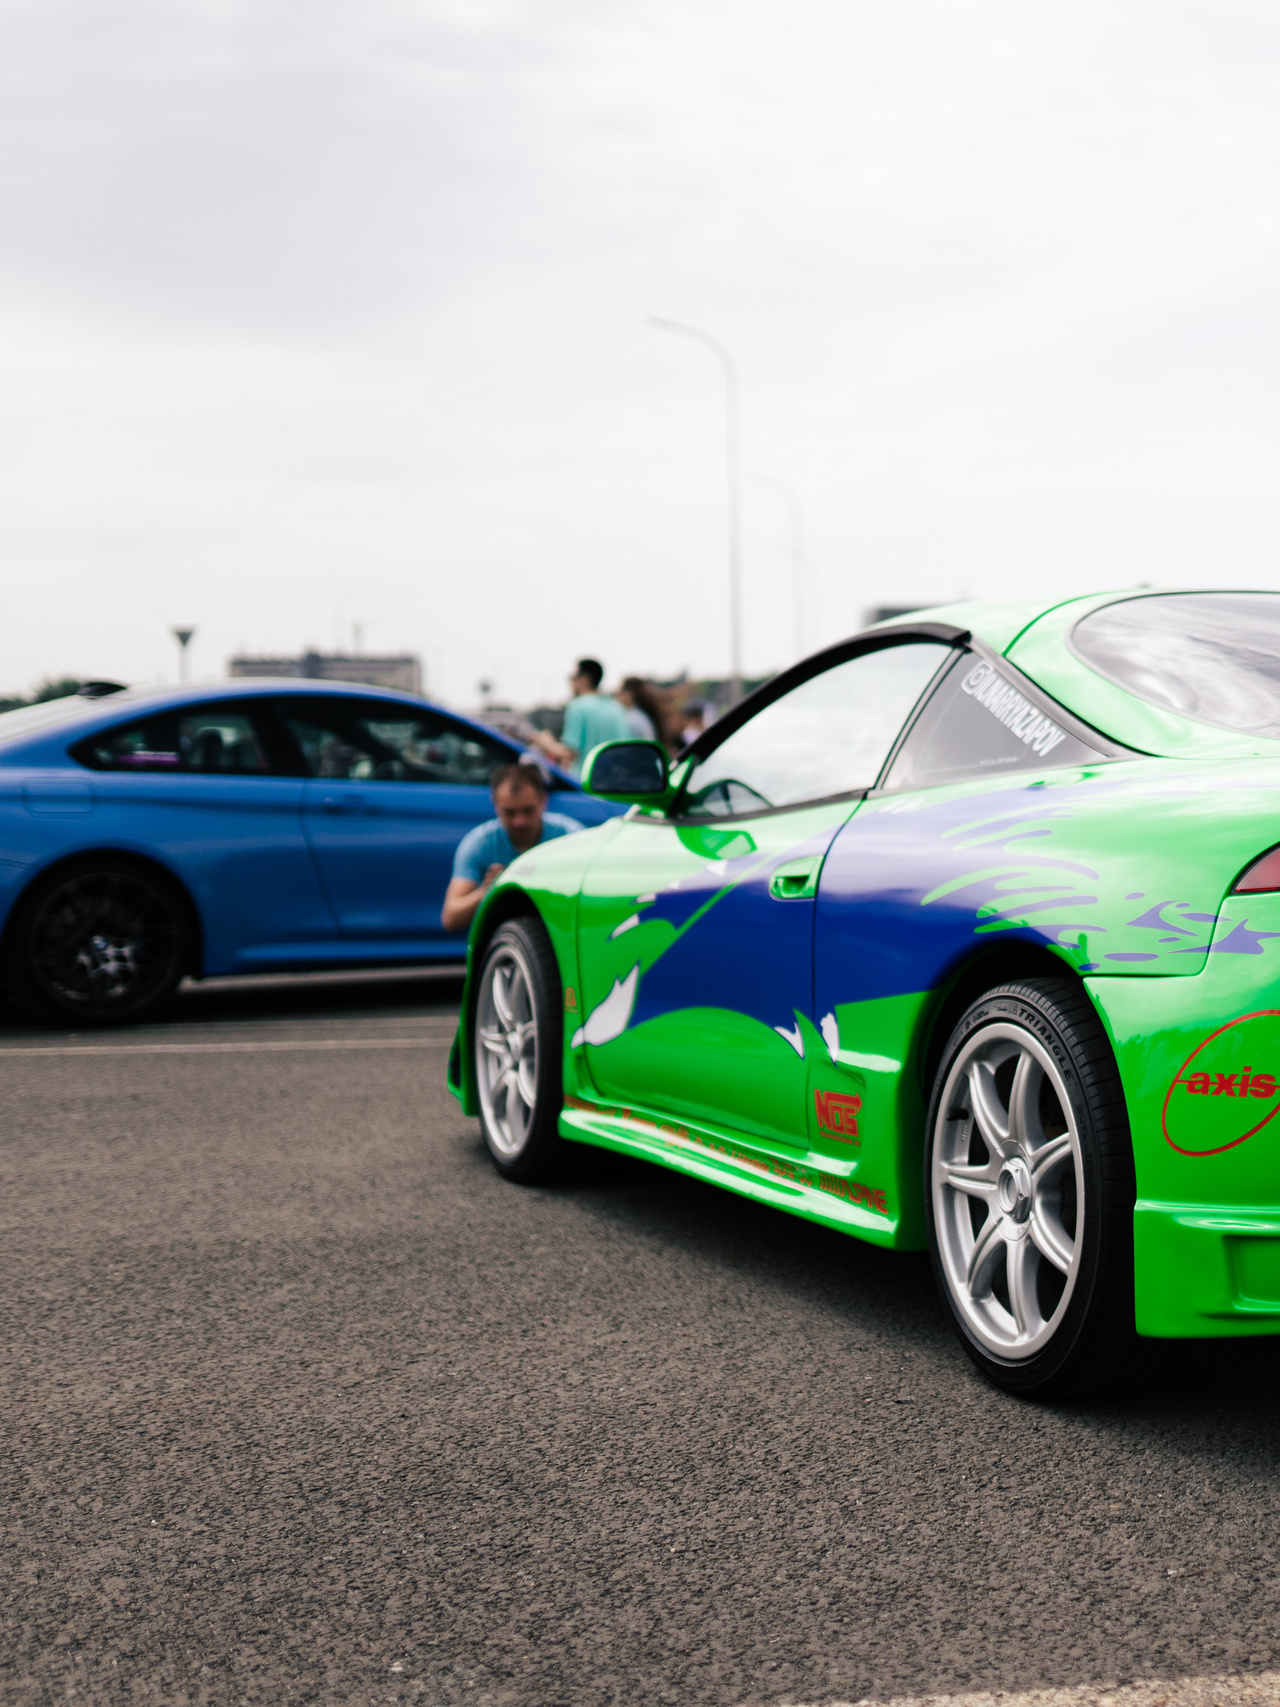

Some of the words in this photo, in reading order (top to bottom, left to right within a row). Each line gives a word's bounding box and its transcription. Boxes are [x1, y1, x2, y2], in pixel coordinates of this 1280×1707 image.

[1019, 1007, 1075, 1082] TRIANGLE
[1186, 1065, 1276, 1099] axis
[814, 1088, 863, 1138] NOS
